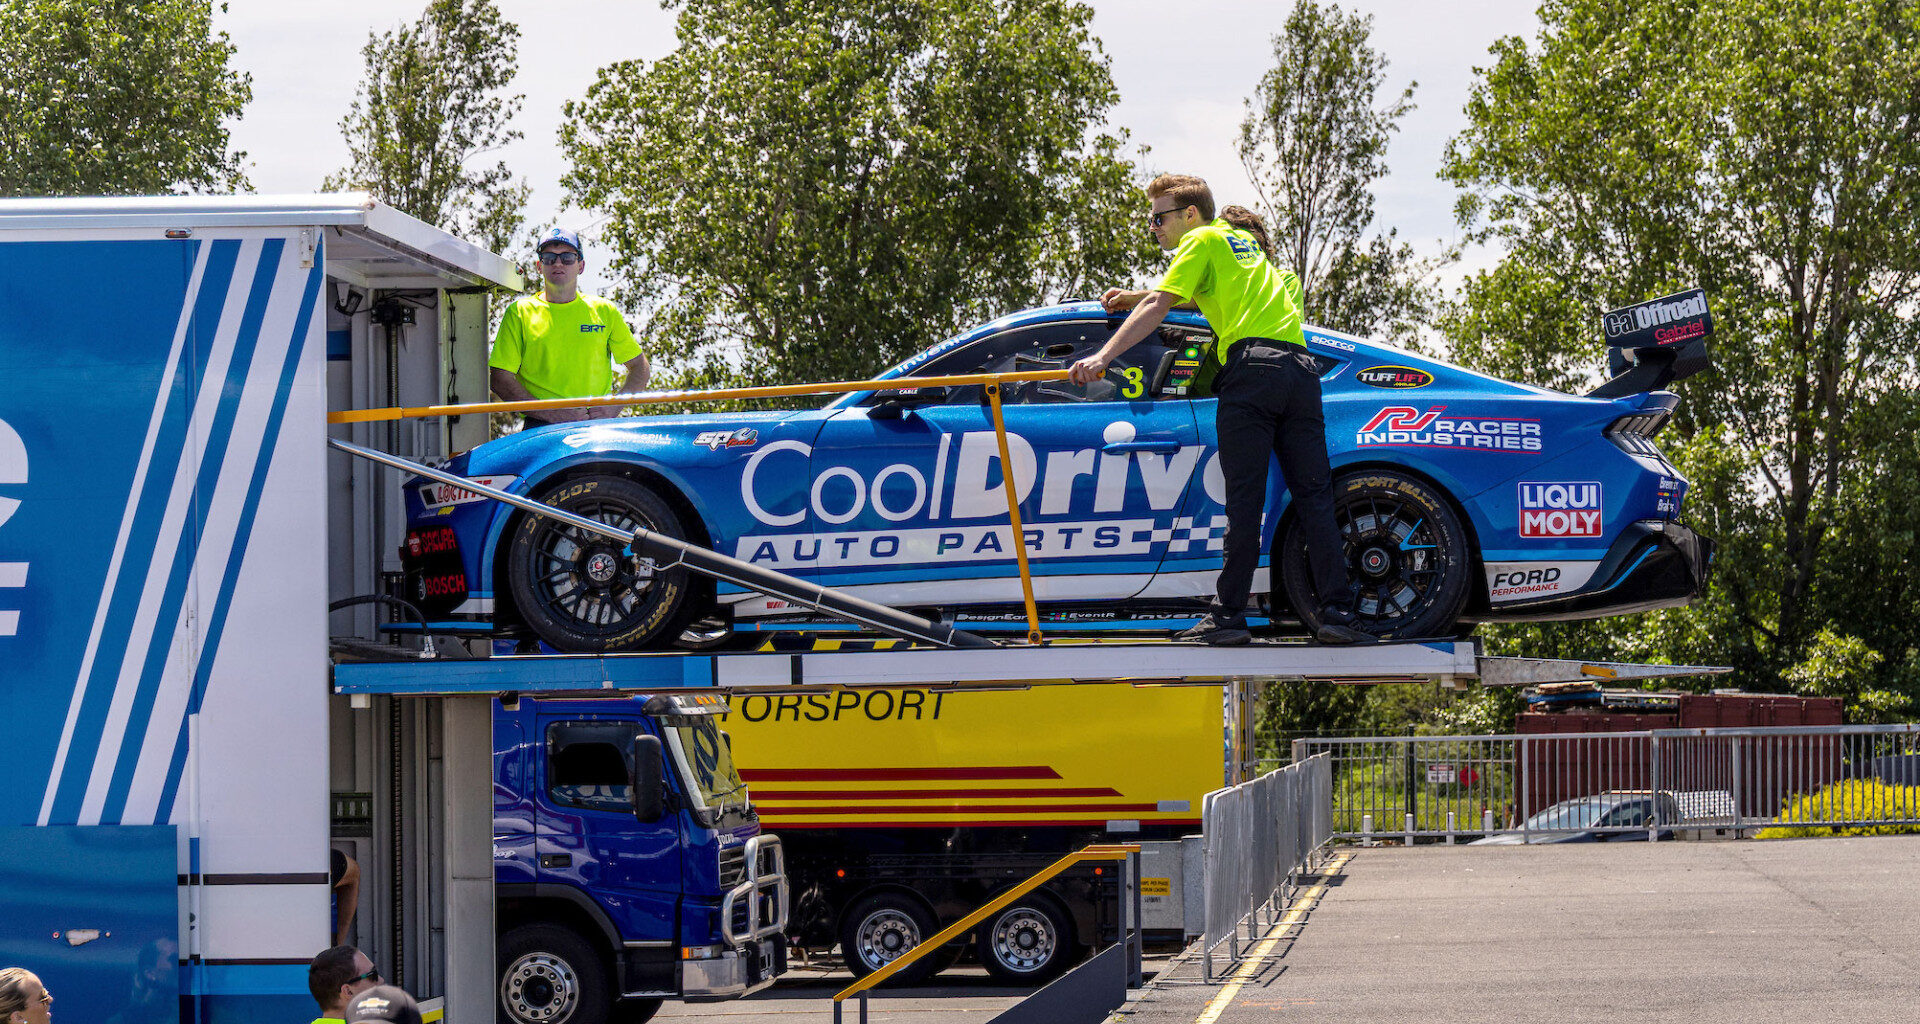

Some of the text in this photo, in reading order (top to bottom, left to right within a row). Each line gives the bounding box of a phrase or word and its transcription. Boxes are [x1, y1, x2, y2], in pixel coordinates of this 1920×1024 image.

[1654, 318, 1704, 341] Gabriel
[1311, 335, 1355, 351] sparco
[1120, 366, 1145, 399] 3
[1434, 420, 1542, 436] RACER
[1356, 432, 1543, 450] INDUSTRIES
[1522, 484, 1597, 510] LIQUI
[1524, 511, 1600, 535] MOLY
[750, 526, 1122, 563] AUTO PARTS
[424, 574, 466, 596] BOSCH
[1493, 567, 1561, 589] FORD
[1491, 582, 1560, 597] PERFORMANCE
